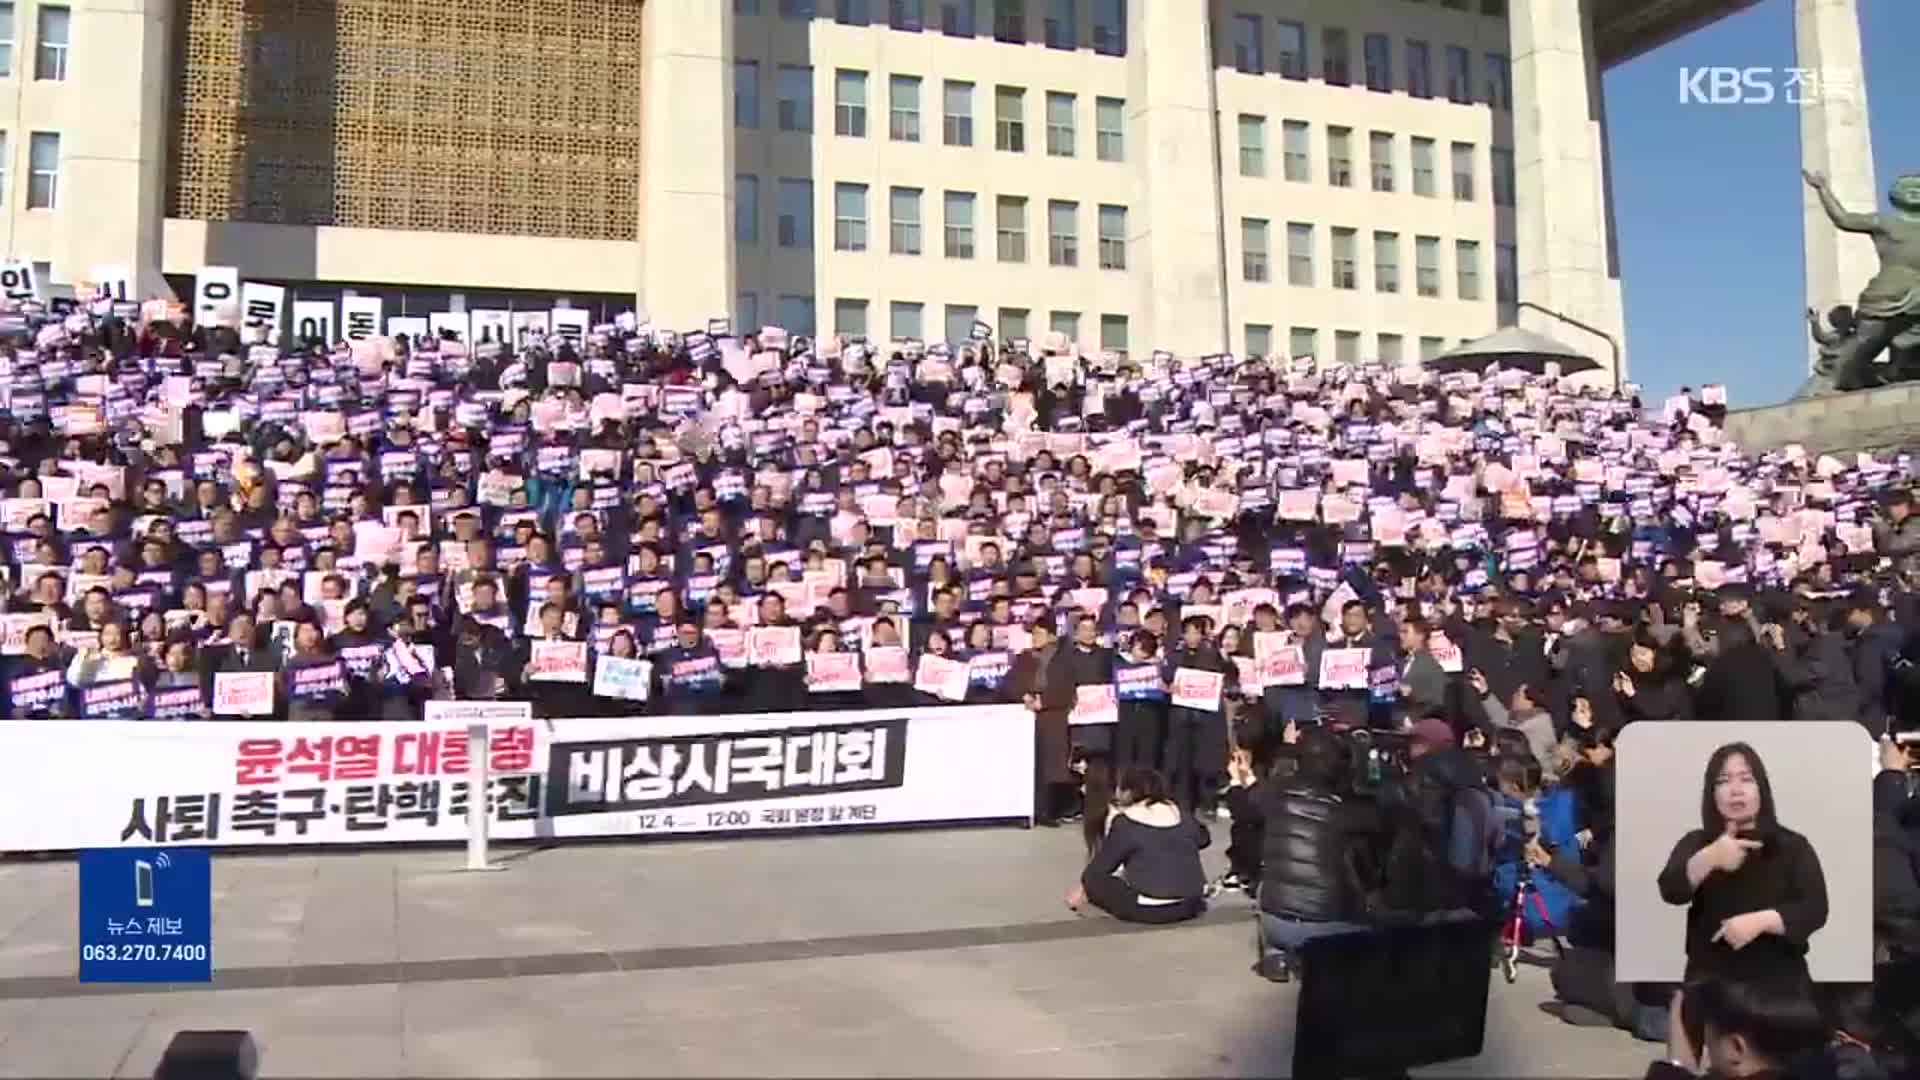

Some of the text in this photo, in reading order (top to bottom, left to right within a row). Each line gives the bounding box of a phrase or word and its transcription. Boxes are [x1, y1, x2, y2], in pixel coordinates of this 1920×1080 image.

[235, 733, 381, 786] 윤석열
[567, 727, 888, 803] 비상시국대회
[120, 792, 220, 842] 사퇴
